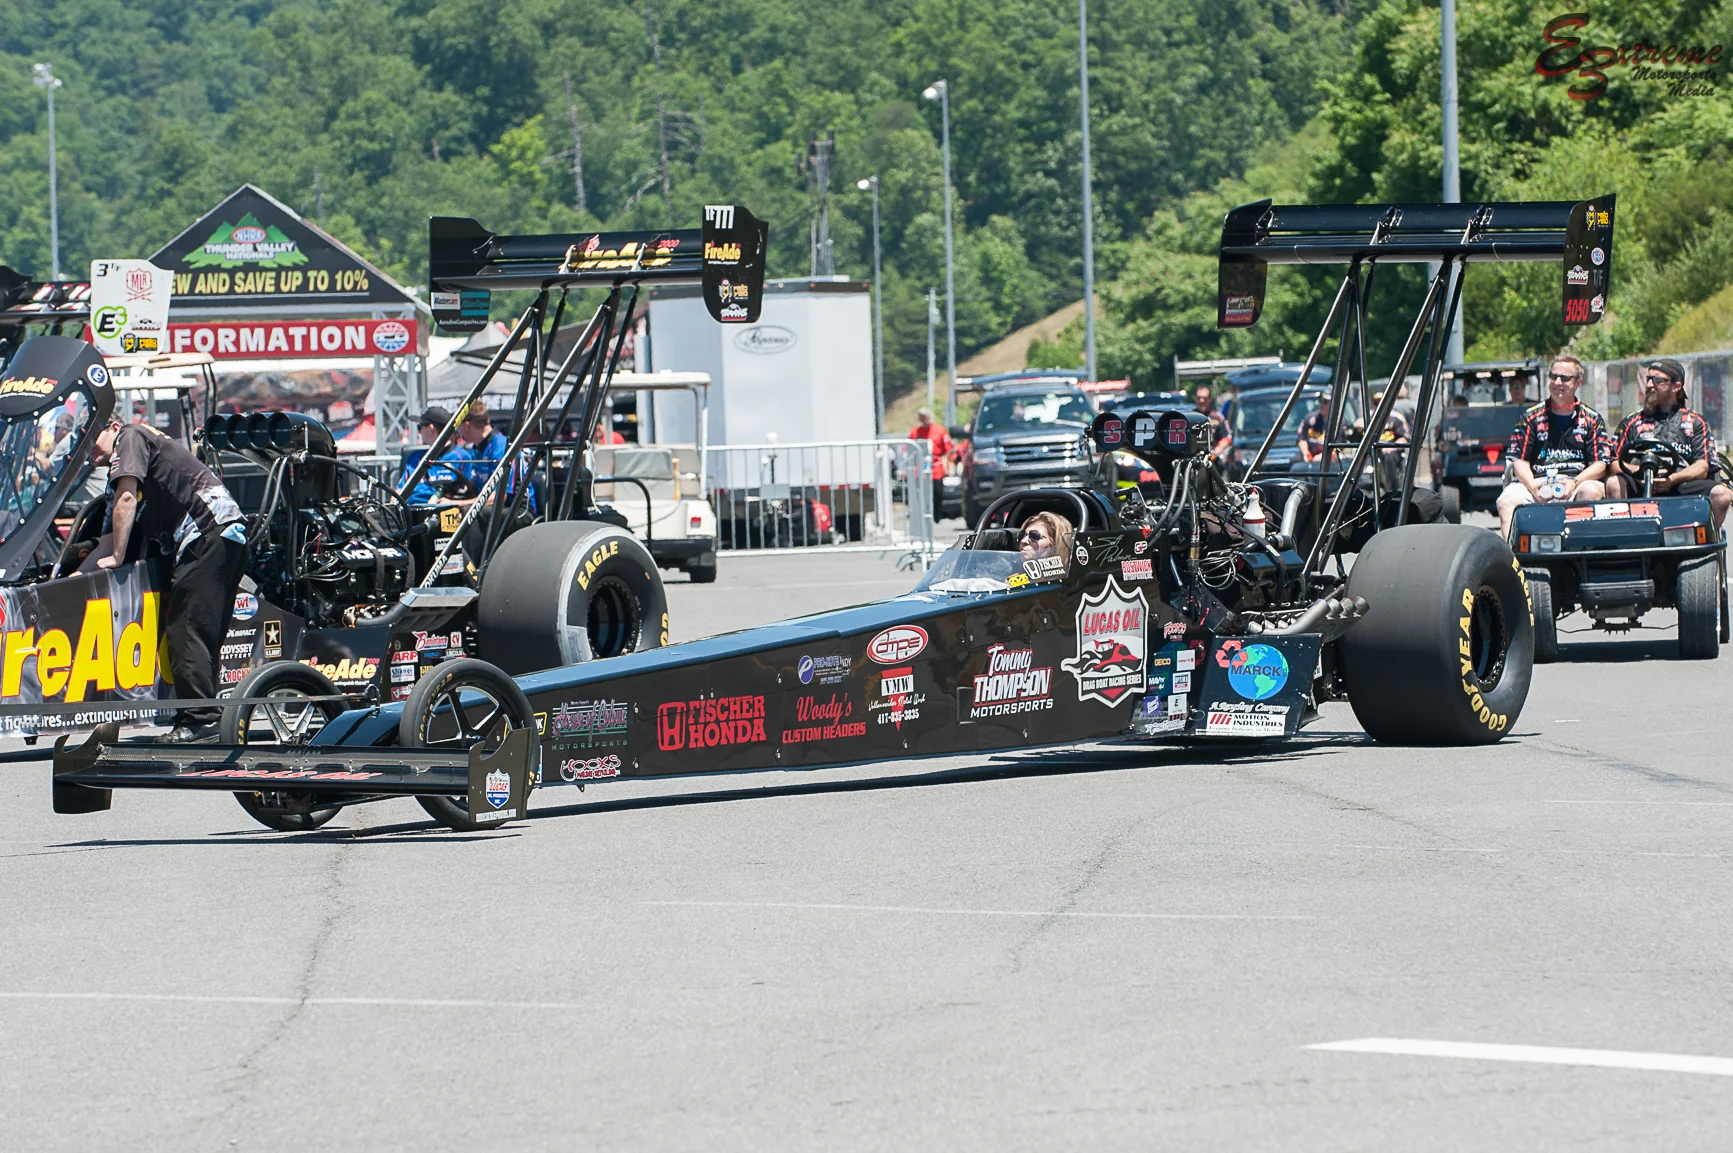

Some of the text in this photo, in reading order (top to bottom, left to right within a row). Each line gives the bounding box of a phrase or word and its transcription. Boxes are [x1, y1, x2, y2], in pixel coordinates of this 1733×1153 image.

[715, 206, 736, 229] 777
[205, 242, 295, 252] THUNDER VALLEY
[226, 251, 275, 260] NATIONALS
[705, 242, 743, 261] FireAde
[96, 263, 109, 277] 3
[131, 273, 147, 291] MLR
[195, 272, 230, 294] AND
[233, 271, 276, 293] SAVE
[279, 270, 303, 292] UP
[307, 270, 329, 292] TO
[334, 269, 369, 291] 10%
[1565, 299, 1589, 322] 5050
[467, 467, 505, 526] GOODYEAR
[576, 540, 619, 591] EAGLE
[1042, 568, 1066, 577] HONDA
[1511, 556, 1535, 627] EAGLE
[1083, 609, 1121, 635] LUCAS
[1123, 607, 1141, 631] OIL
[220, 643, 254, 655] ODYSSEY
[392, 651, 418, 662] ARP
[1459, 587, 1508, 732] GOODYEAR
[988, 644, 1032, 681] Tommy
[1230, 665, 1281, 677] MARCK
[885, 677, 910, 693] VMW
[973, 669, 1051, 704] THOMPSON
[1082, 678, 1096, 691] DRAG
[1096, 677, 1108, 689] BOAT
[1109, 675, 1126, 688] RACING
[1126, 674, 1142, 686] SERIES
[688, 695, 765, 724] FISCHER
[796, 692, 852, 726] Woody's
[970, 697, 1054, 719] MOTORSPORTS
[1255, 702, 1291, 714] Company
[688, 718, 767, 748] HONDA
[782, 721, 866, 744] CUSTOM HEADERS
[552, 740, 628, 751] MOTORSPORTS
[489, 782, 508, 791] LUCAS
